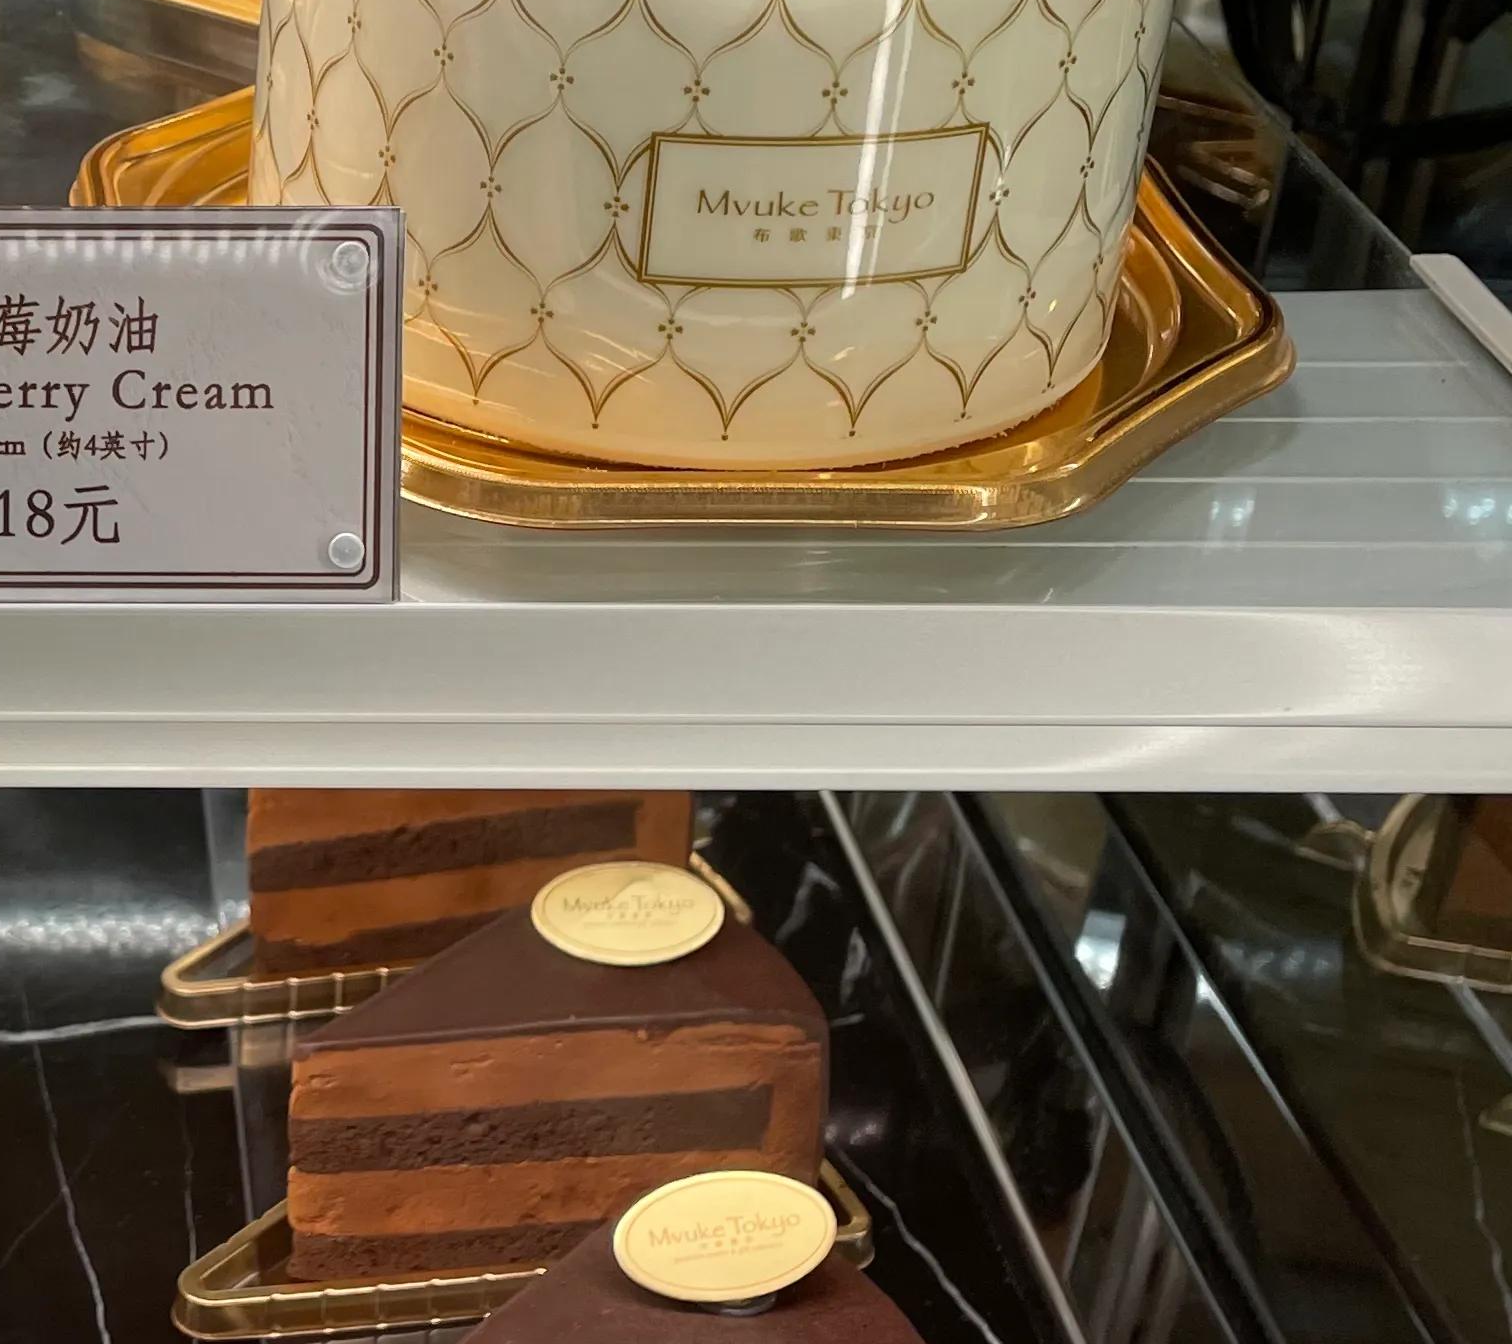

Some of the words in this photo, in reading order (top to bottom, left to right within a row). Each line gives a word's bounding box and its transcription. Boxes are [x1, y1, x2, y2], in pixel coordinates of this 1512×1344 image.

[696, 188, 819, 217] Mvuke
[828, 189, 935, 224] Tokyo
[112, 370, 274, 411] Cream
[648, 1223, 726, 1247] Mvuke
[726, 1213, 801, 1236] Tokyo
